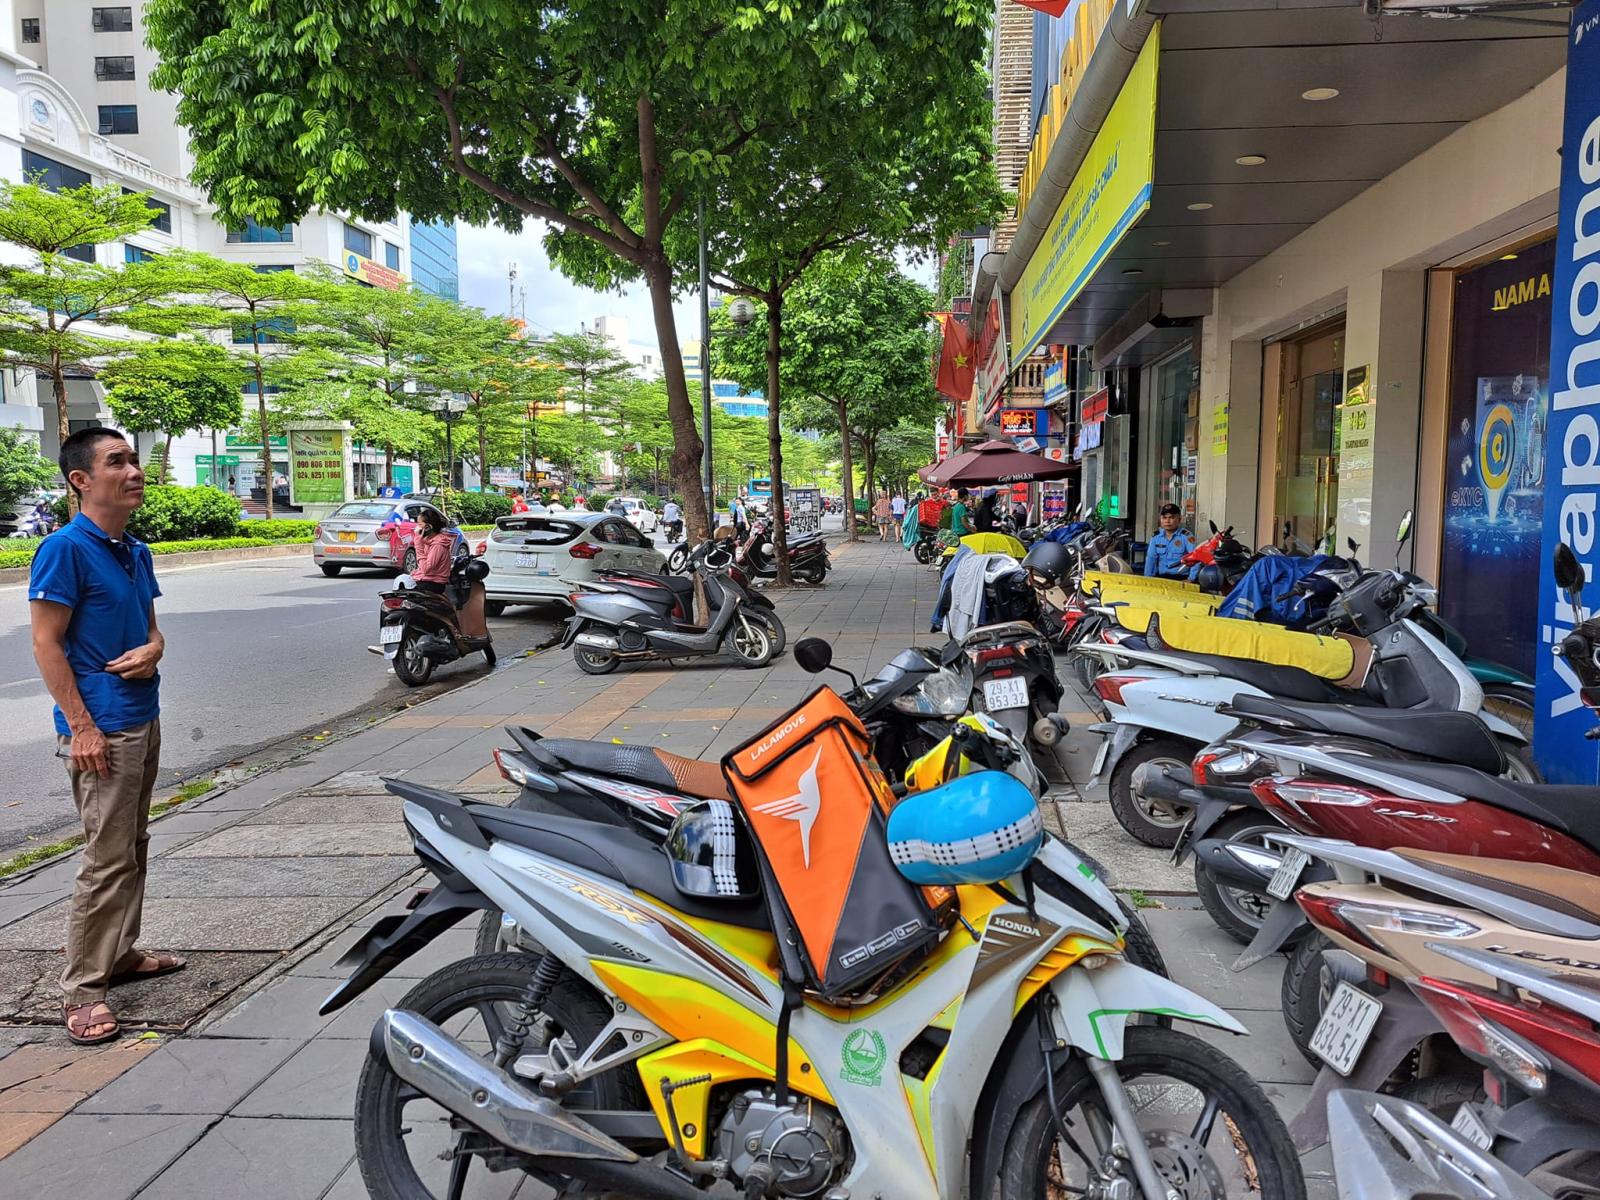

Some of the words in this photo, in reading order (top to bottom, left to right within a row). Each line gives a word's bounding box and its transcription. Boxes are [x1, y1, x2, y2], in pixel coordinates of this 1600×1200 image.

[1494, 277, 1536, 308] NAM
[1537, 273, 1551, 298] A
[1451, 486, 1483, 507] eKYC
[990, 693, 1026, 708] 953.32
[751, 714, 806, 760] LALAMOVE
[995, 917, 1041, 937] HONDA
[1331, 989, 1372, 1032] 29-X1
[1314, 1018, 1357, 1068] 834.54
